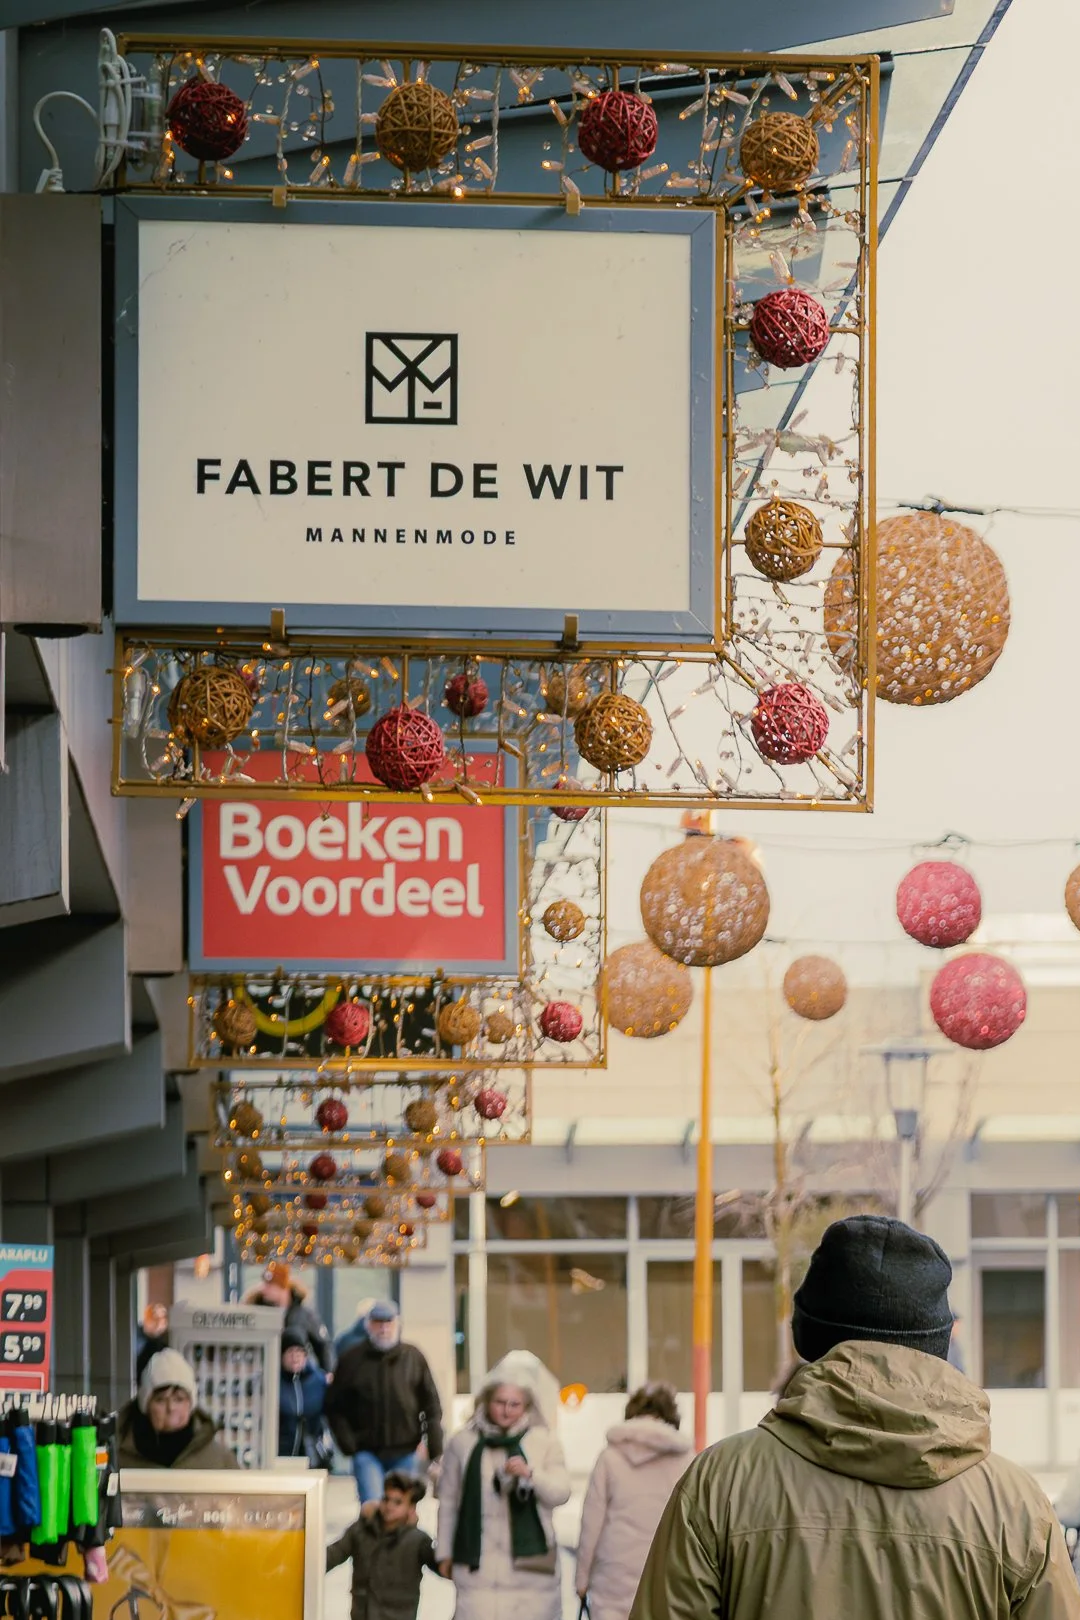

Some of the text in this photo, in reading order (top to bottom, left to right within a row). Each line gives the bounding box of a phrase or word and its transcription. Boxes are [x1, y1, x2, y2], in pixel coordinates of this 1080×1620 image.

[196, 458, 625, 501] FABERT DE WIT
[304, 527, 517, 546] MANNENMODE
[218, 801, 464, 863] Boeken
[222, 861, 486, 919] Voordeel
